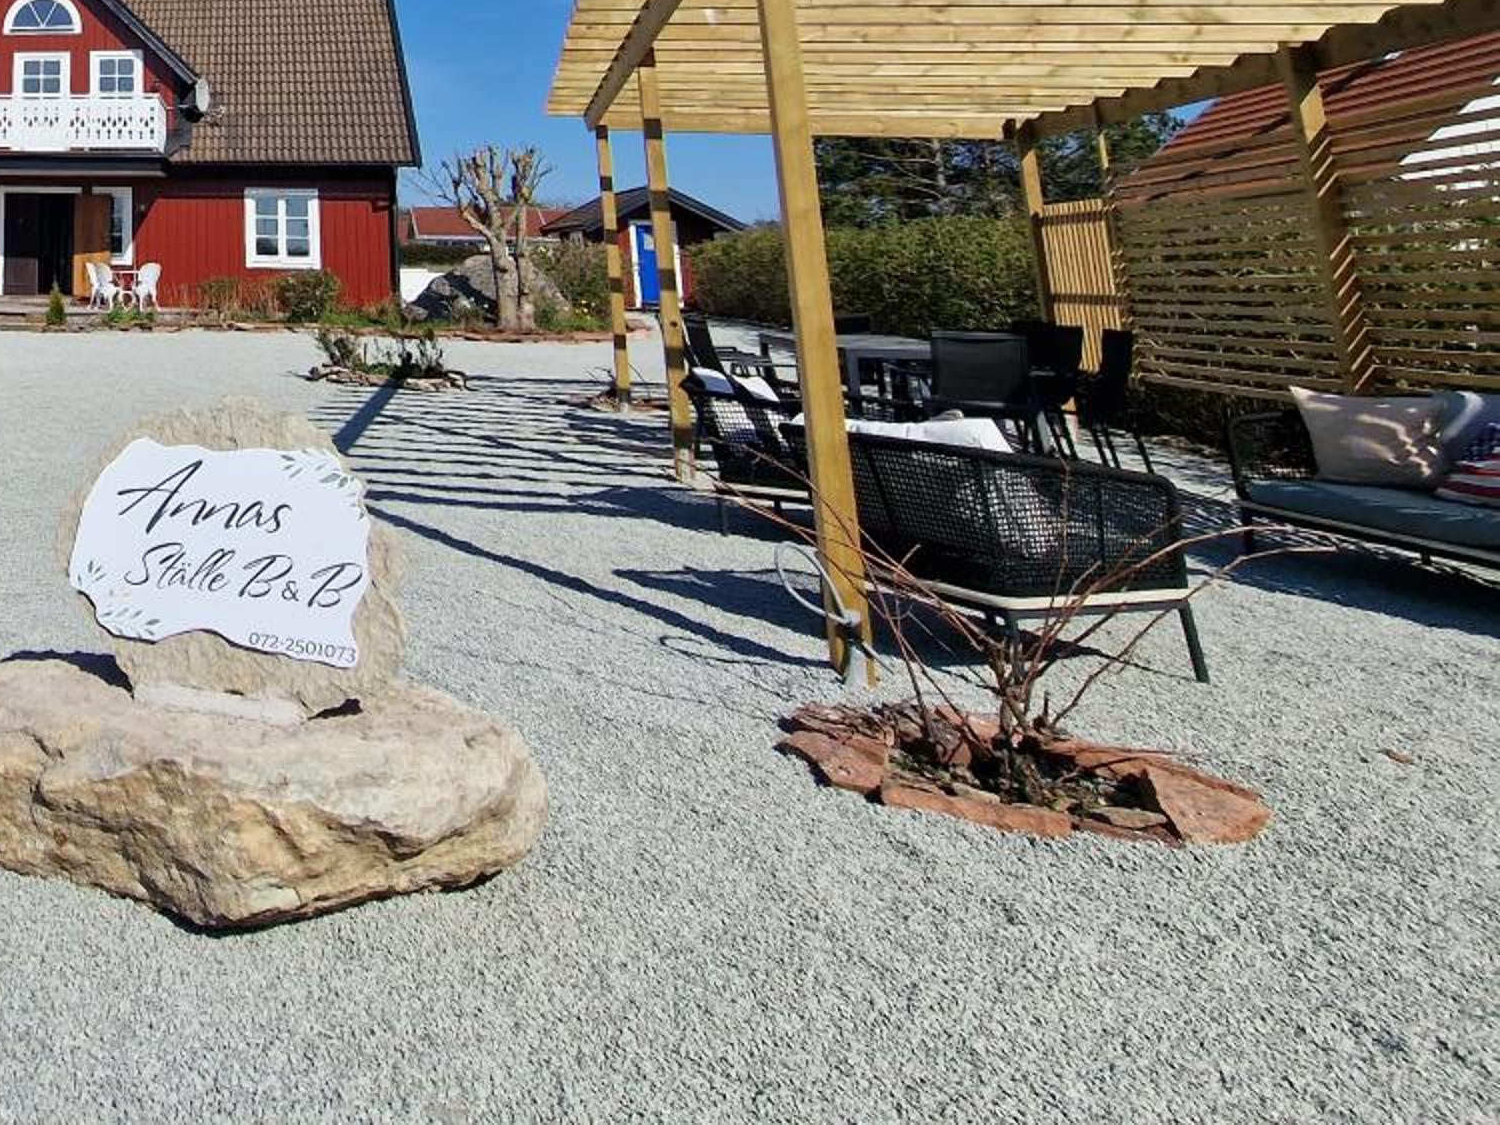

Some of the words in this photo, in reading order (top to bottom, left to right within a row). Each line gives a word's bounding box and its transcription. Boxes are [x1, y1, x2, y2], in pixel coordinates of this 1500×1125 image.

[117, 460, 291, 534] Annas
[124, 542, 235, 592] Ställe
[238, 554, 362, 608] B&B
[249, 631, 357, 663] 072-2501073
